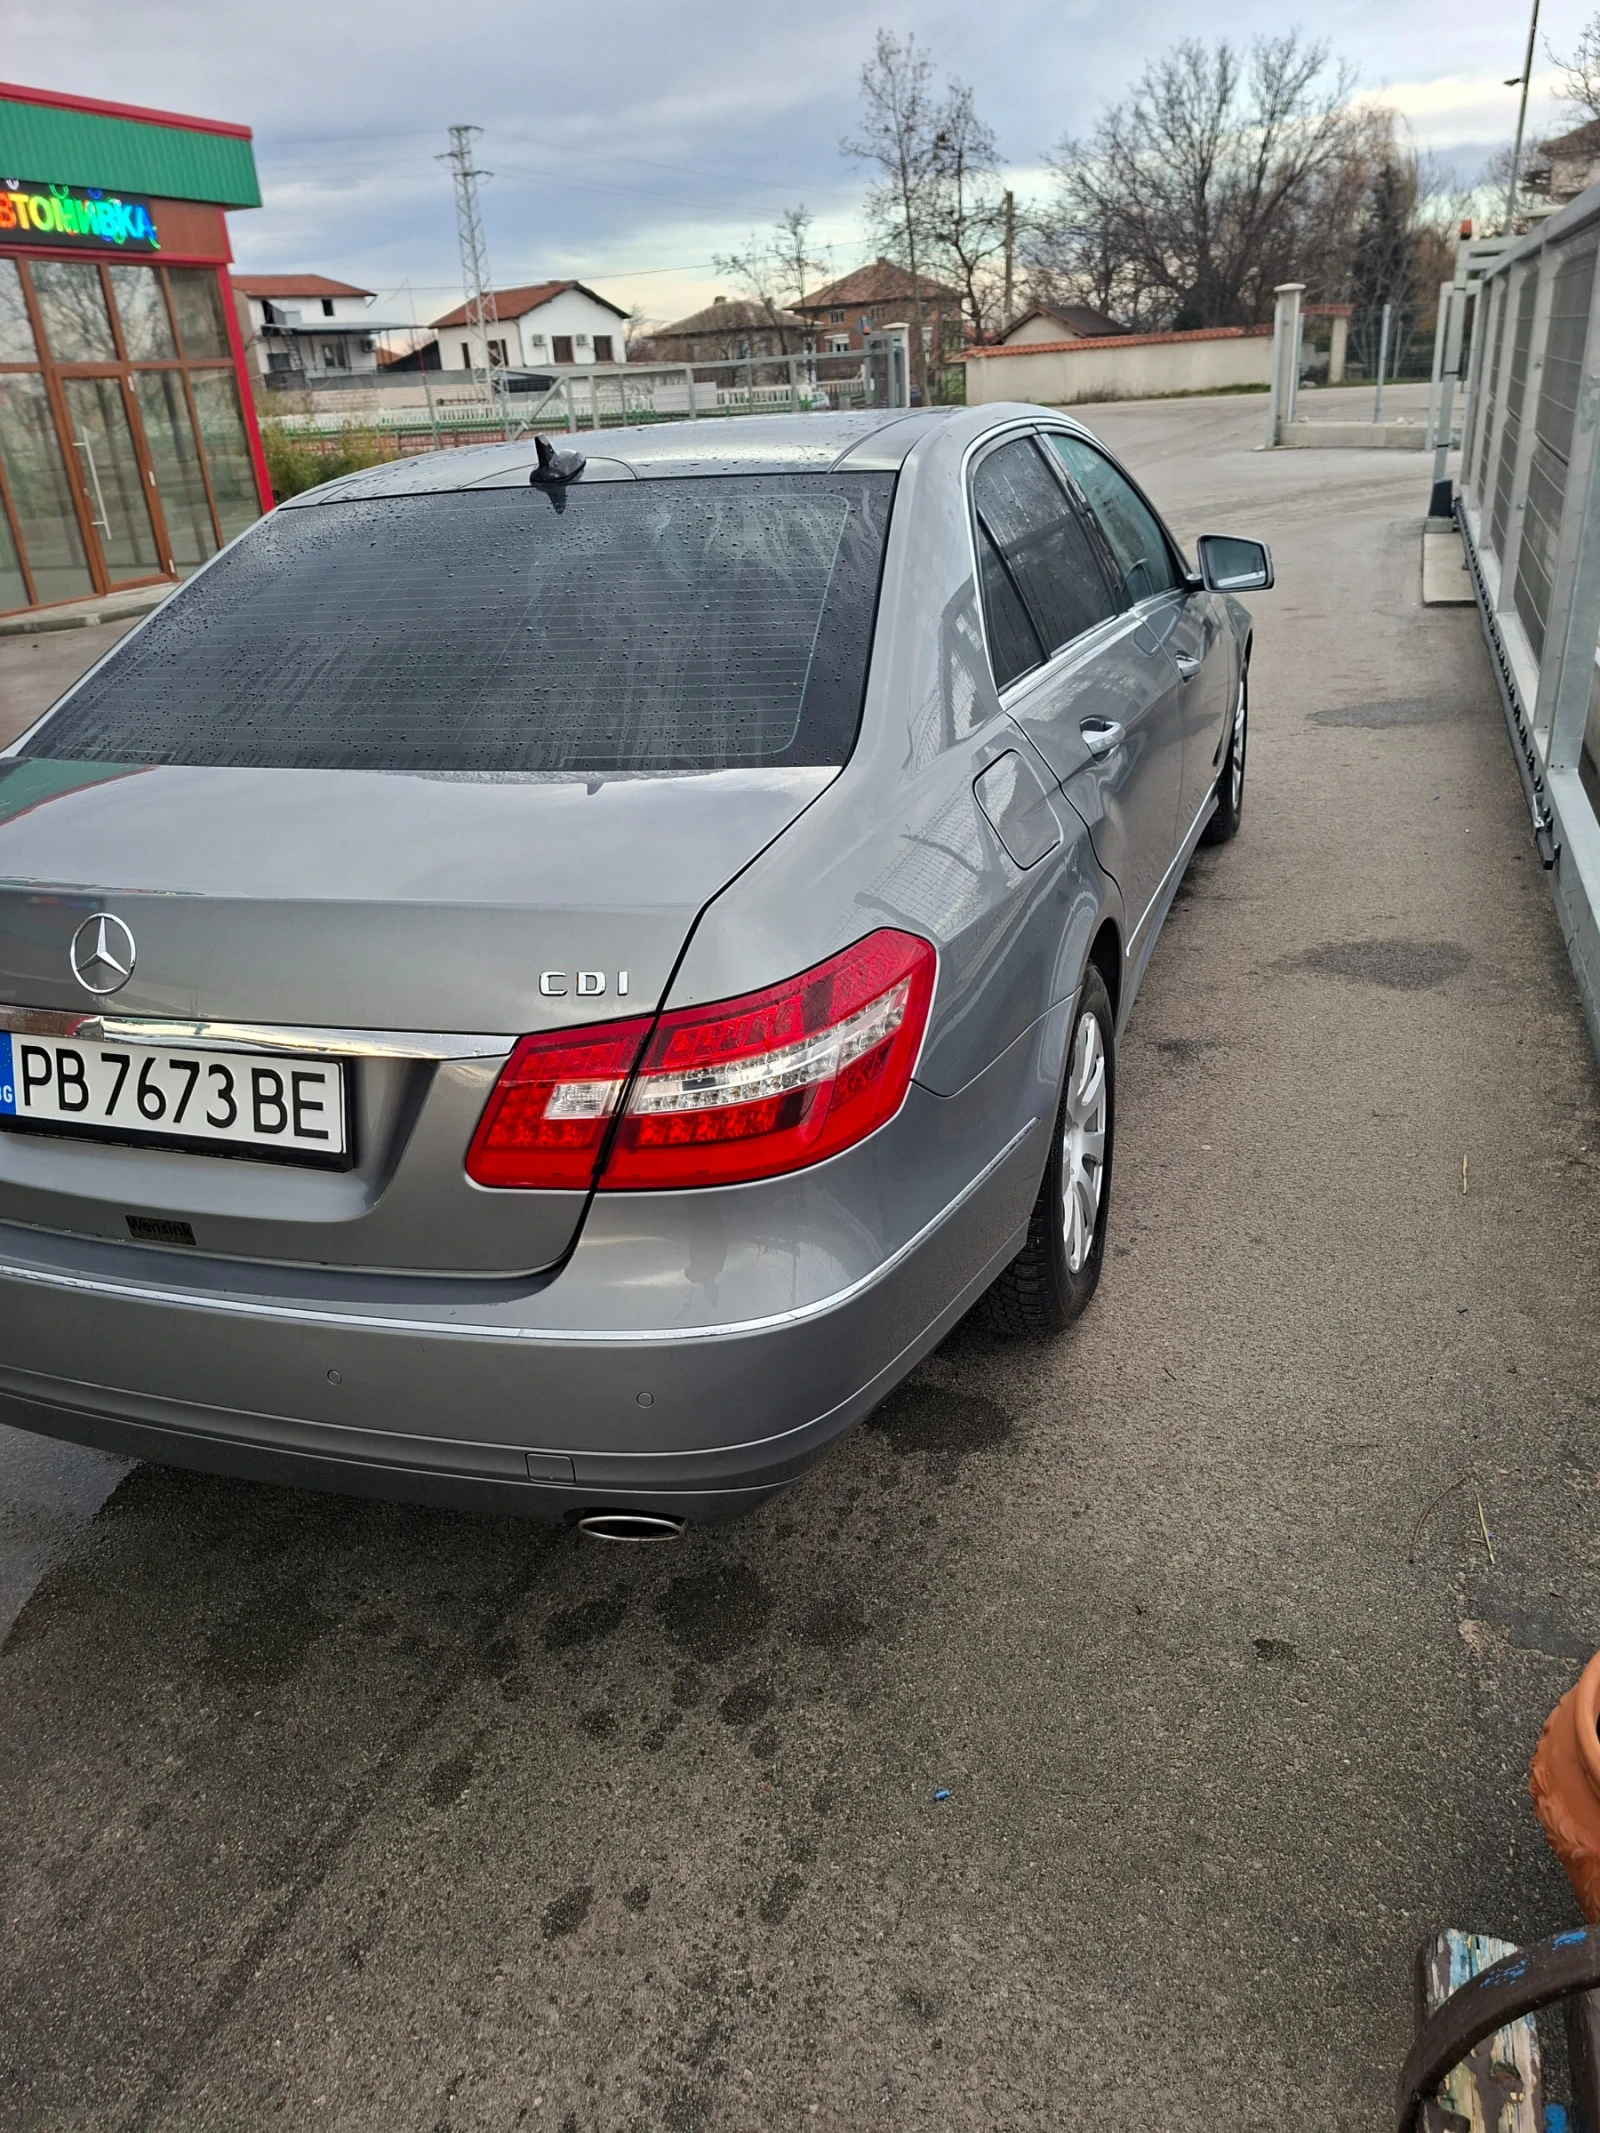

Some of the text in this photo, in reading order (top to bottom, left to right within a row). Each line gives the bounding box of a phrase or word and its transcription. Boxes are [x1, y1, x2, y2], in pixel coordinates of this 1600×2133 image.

[539, 971, 629, 996] CDI
[0, 1084, 13, 1104] G
[20, 1044, 330, 1140] PB 7673 BE
[126, 1215, 194, 1238] Wensink
